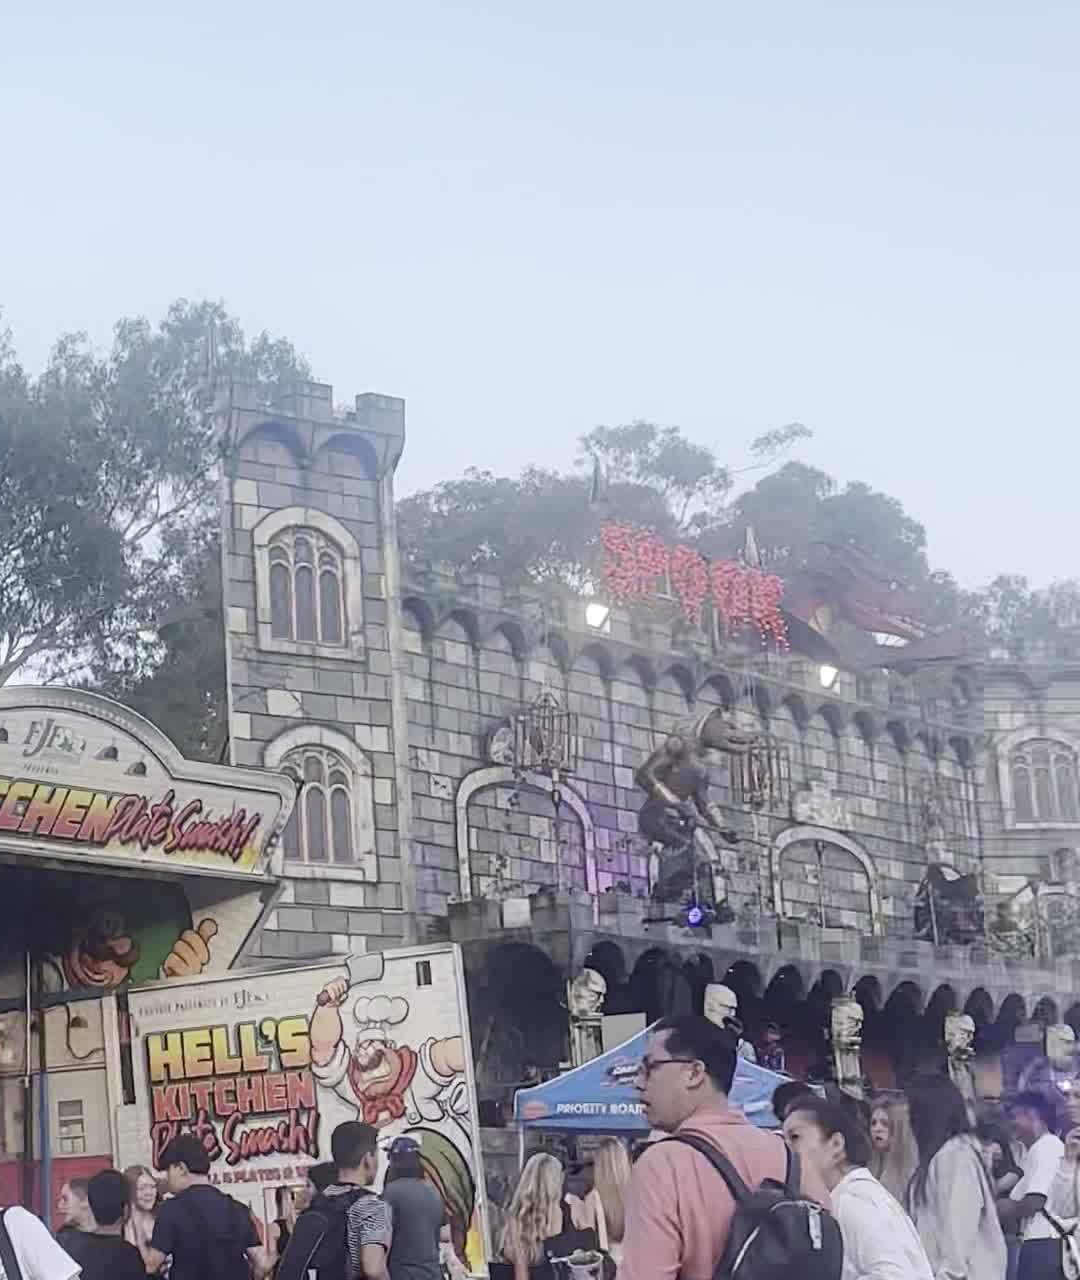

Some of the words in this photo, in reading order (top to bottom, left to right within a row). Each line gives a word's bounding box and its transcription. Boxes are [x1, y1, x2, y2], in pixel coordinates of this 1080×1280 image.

[146, 1015, 310, 1083] HELL'S
[152, 1071, 317, 1124] KITCHEN
[556, 1102, 606, 1115] PRIORITY
[222, 1107, 320, 1166] Smash!
